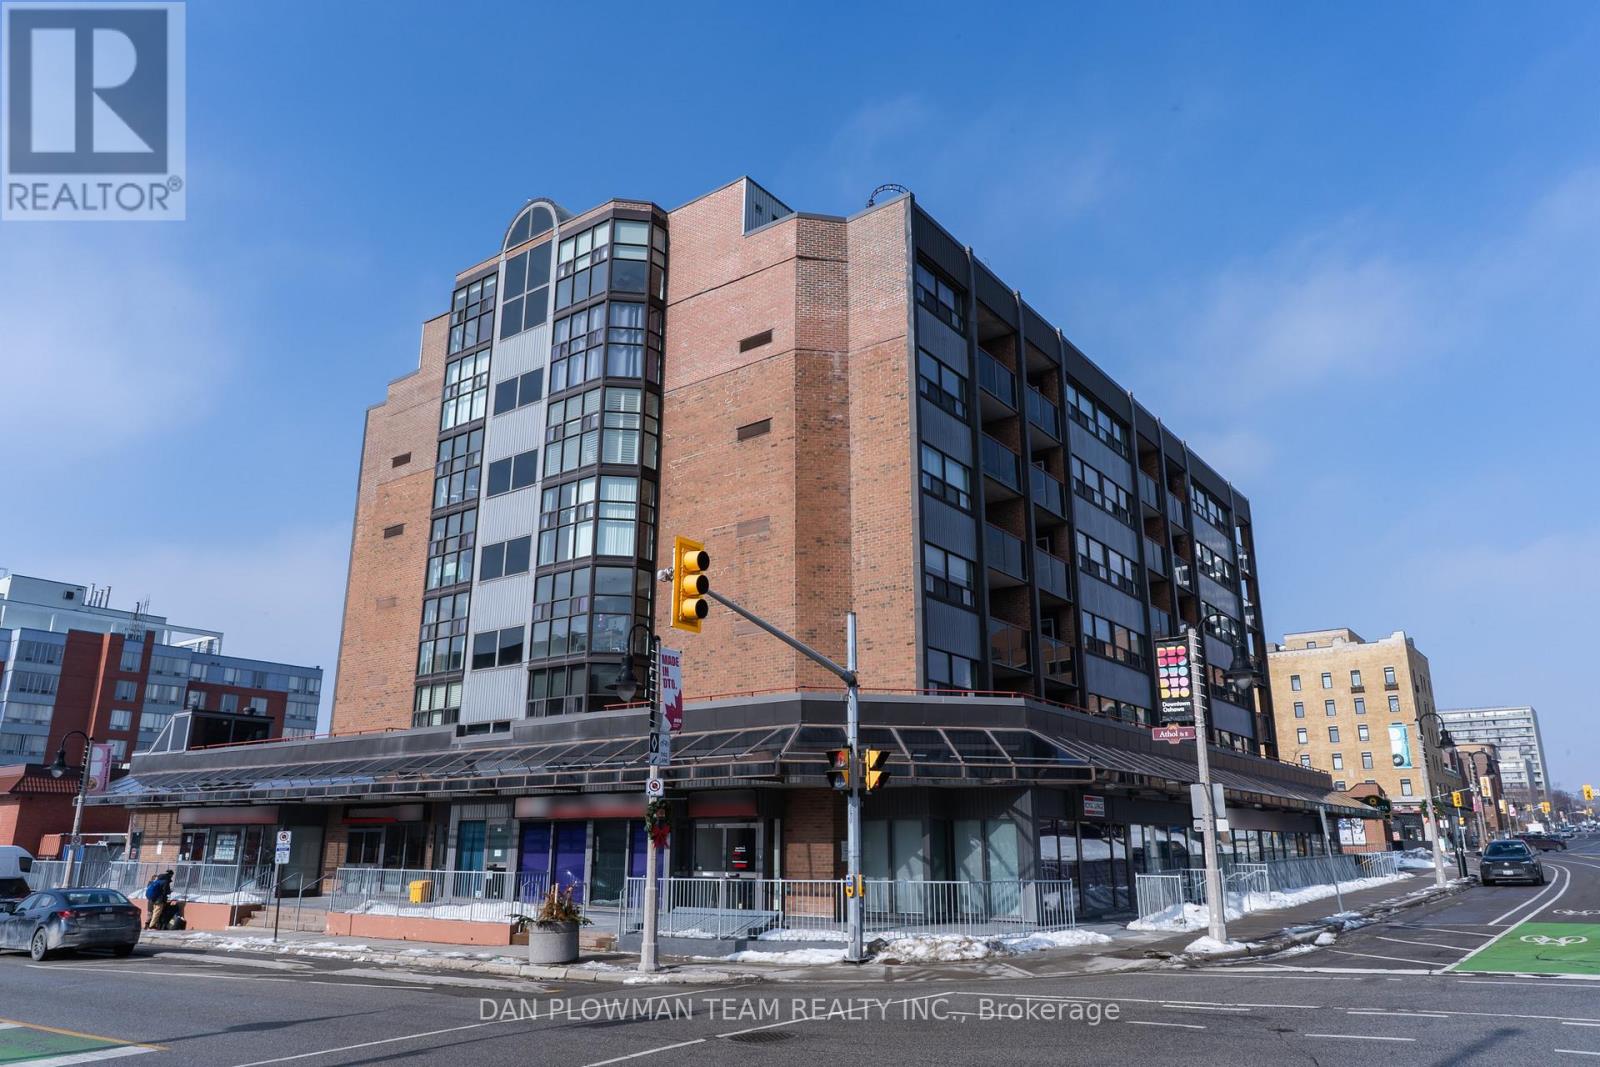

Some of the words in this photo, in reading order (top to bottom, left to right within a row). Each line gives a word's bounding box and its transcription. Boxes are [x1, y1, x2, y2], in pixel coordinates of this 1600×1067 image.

[661, 654, 680, 667] MADE
[662, 666, 669, 677] IN
[1159, 730, 1178, 738] Athol
